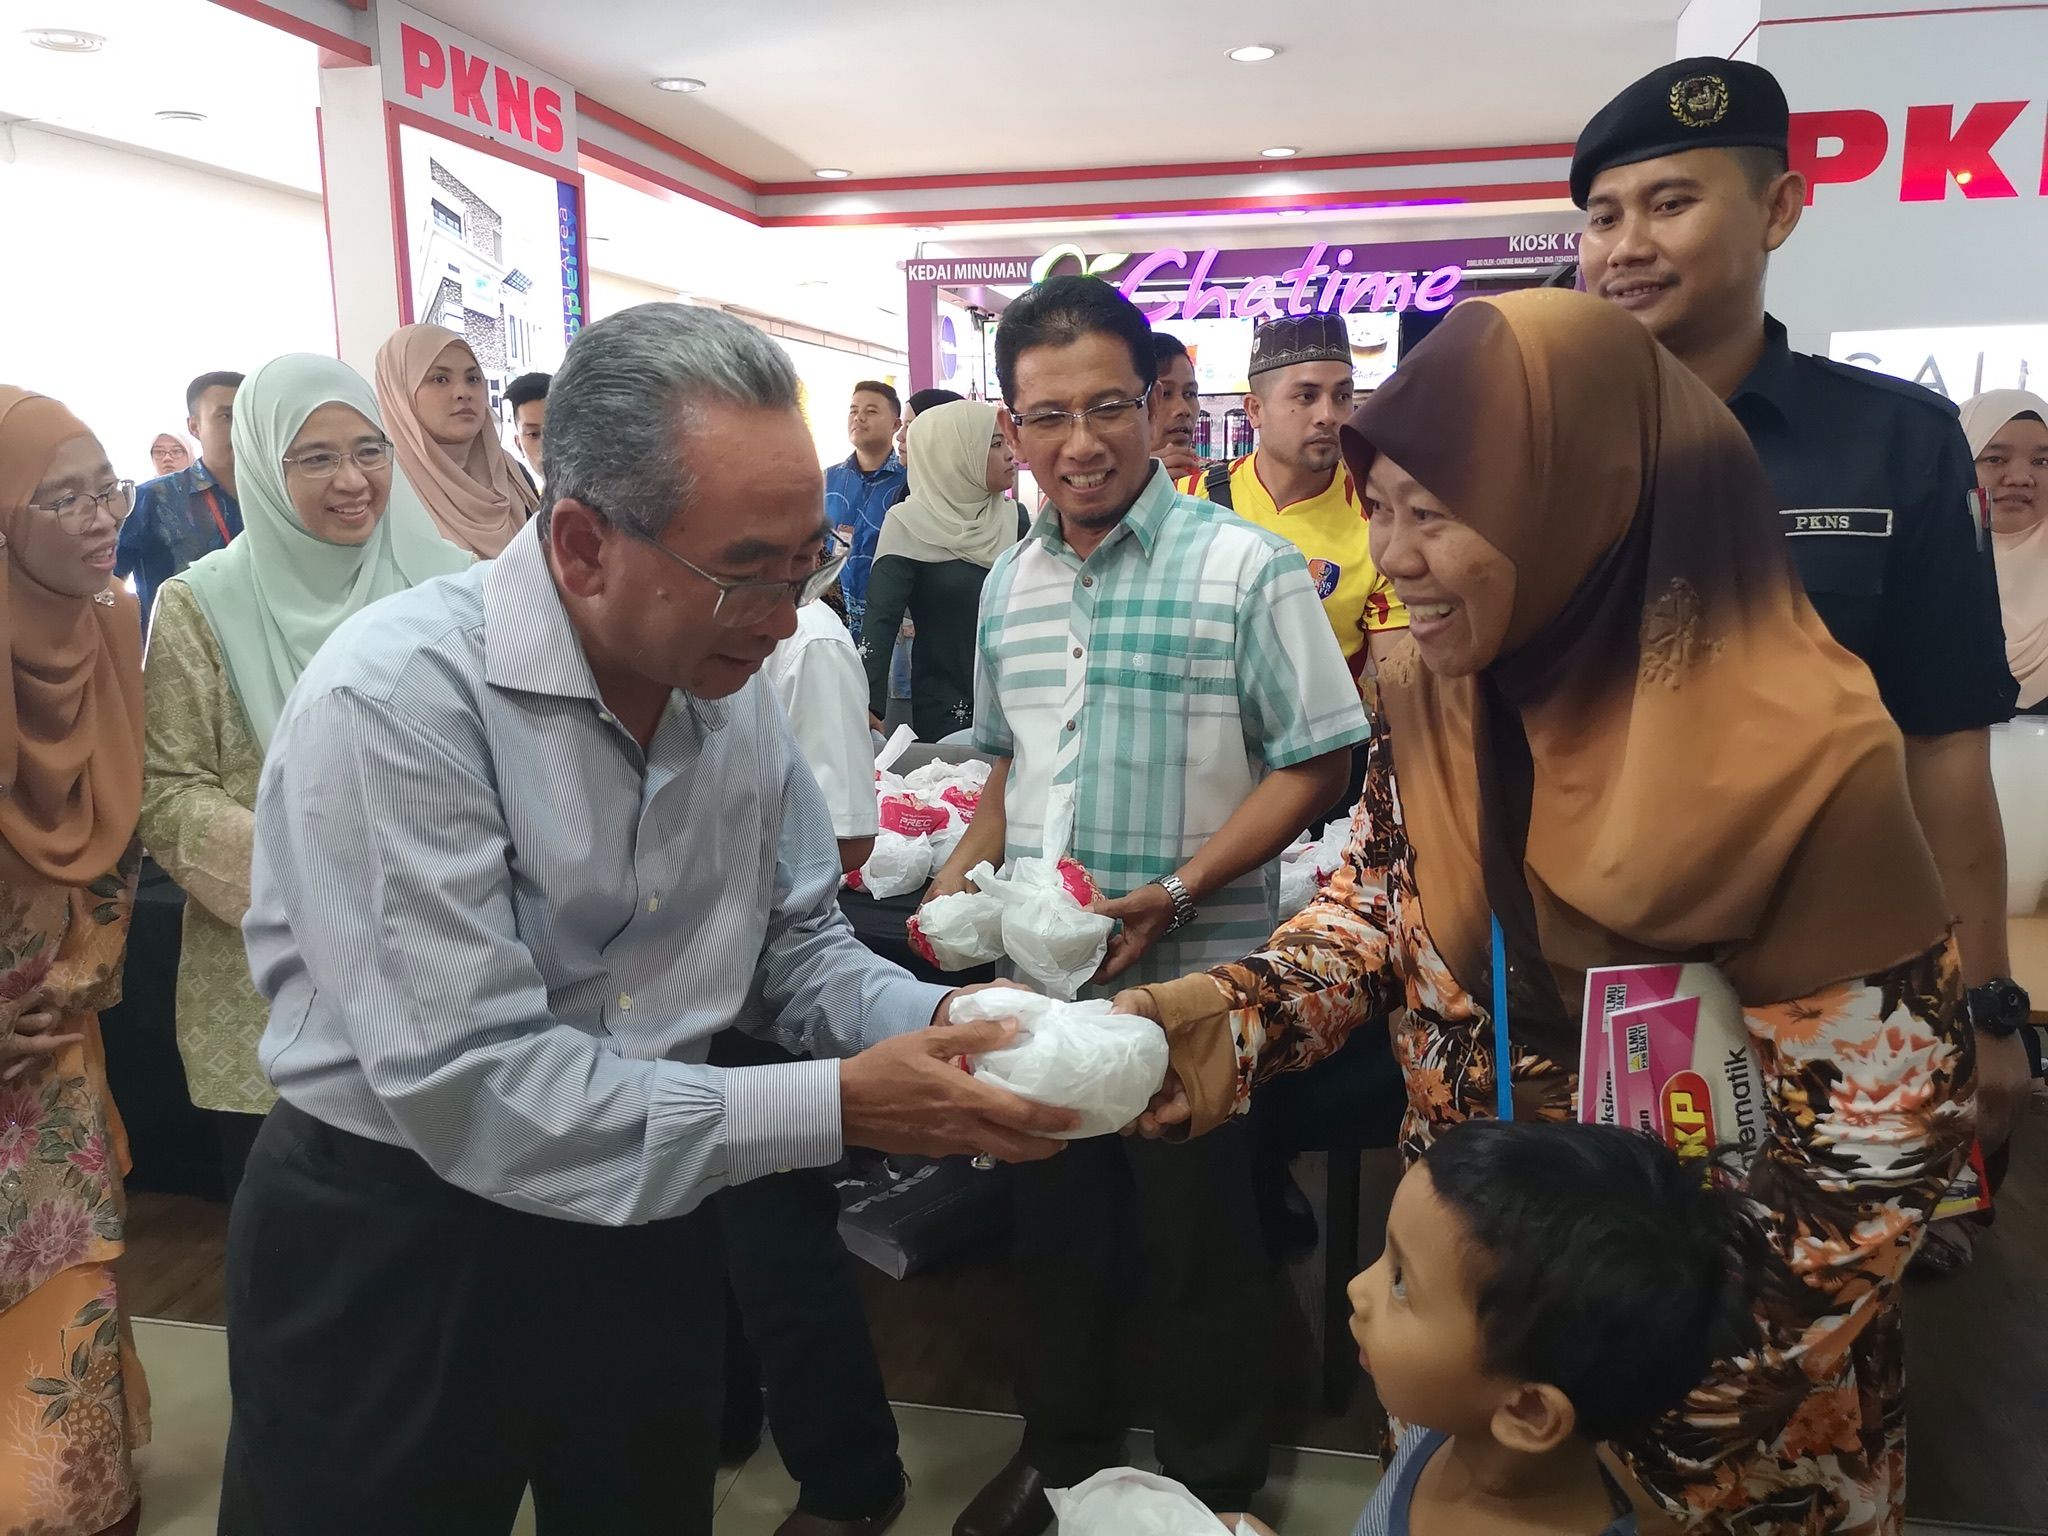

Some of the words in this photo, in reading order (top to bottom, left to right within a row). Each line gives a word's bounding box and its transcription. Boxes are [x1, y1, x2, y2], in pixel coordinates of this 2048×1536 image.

[401, 22, 564, 153] PKNS
[1788, 100, 2048, 206] PK
[559, 207, 571, 274] Area
[1509, 234, 1559, 252] KIOSK
[908, 264, 951, 281] KEDAI
[954, 262, 1028, 279] MINUMAN
[1118, 241, 1462, 324] Chatime
[1795, 515, 1850, 529] PKNS
[1605, 986, 1617, 1014] ILMU
[1628, 1027, 1639, 1054] ILMU
[1638, 1025, 1648, 1052] BAKTI
